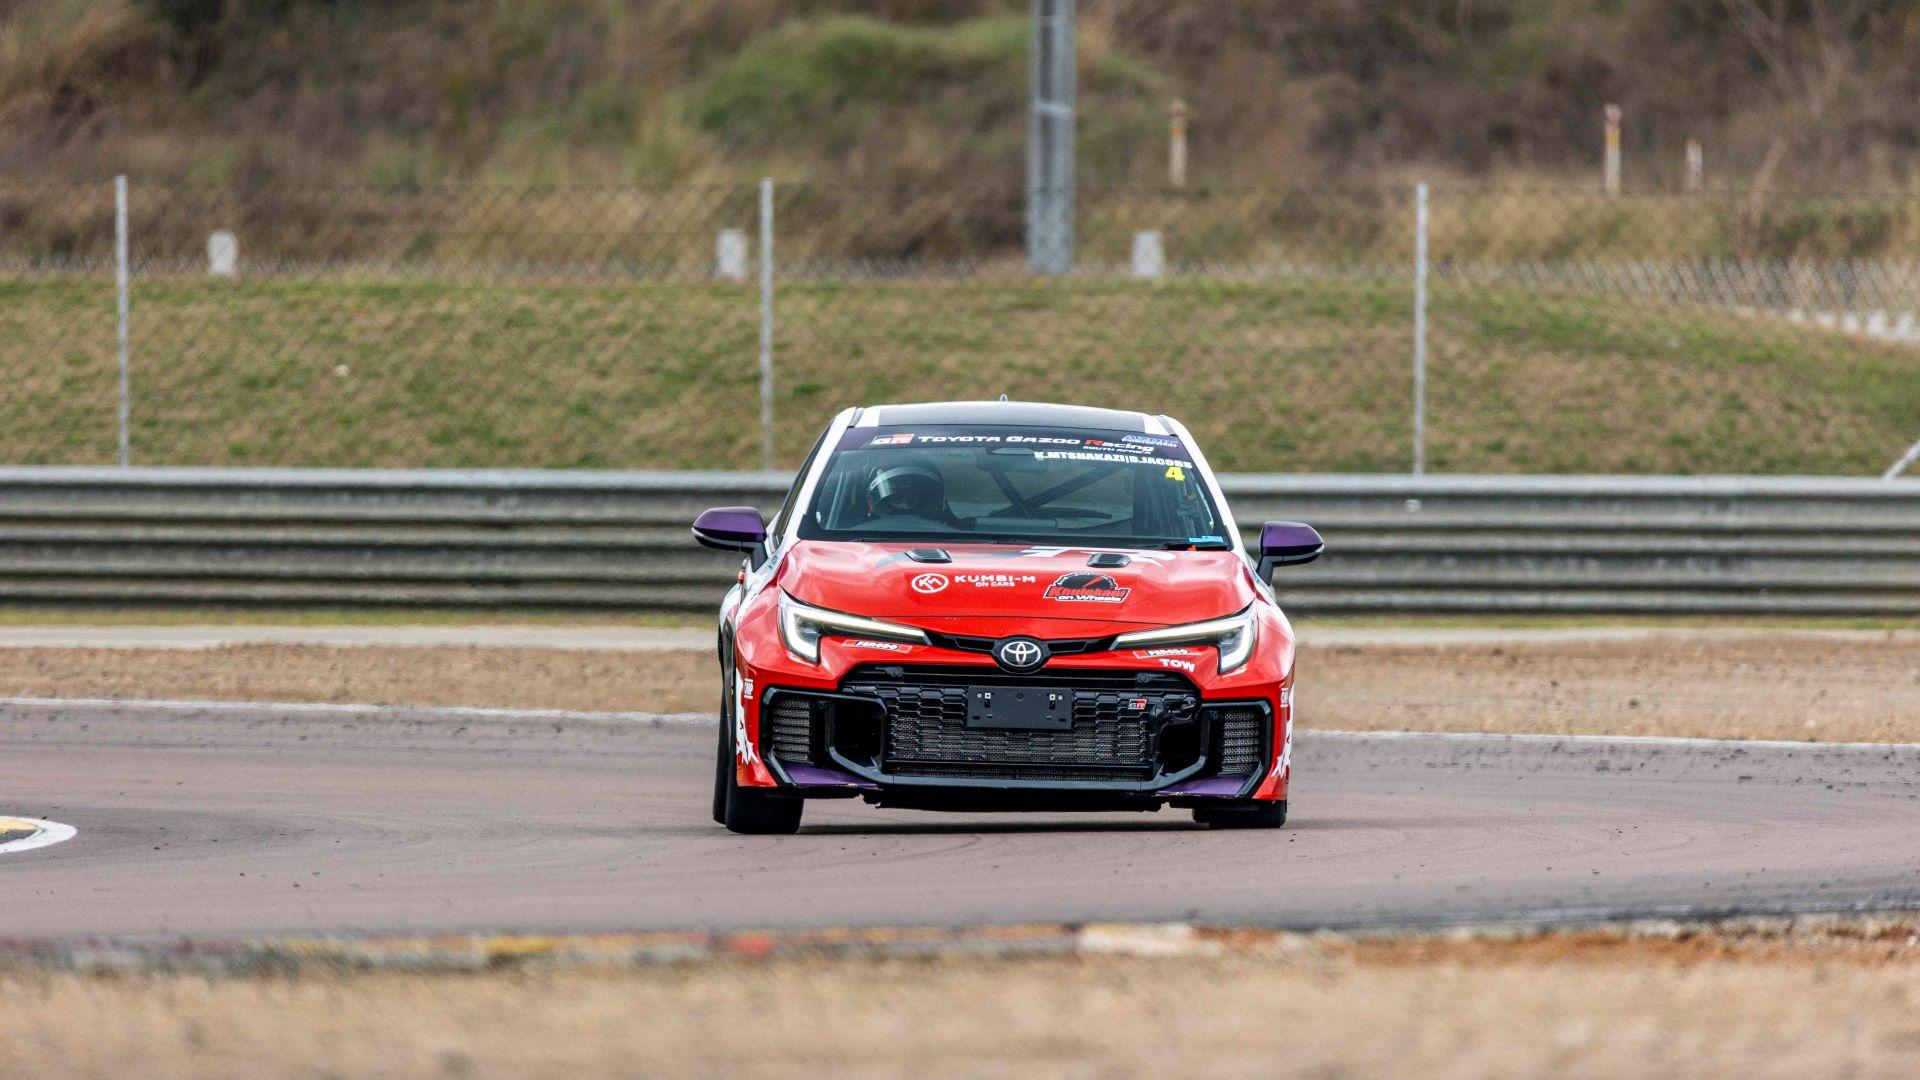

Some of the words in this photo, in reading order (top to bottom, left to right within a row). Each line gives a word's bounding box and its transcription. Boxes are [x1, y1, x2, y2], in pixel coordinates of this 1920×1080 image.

[1006, 436, 1080, 445] GAZOO
[1085, 439, 1154, 453] Racing
[1165, 466, 1185, 482] 4
[955, 575, 1036, 583] KUMBI-M
[1159, 659, 1195, 673] TOW
[1129, 700, 1146, 709] GR
